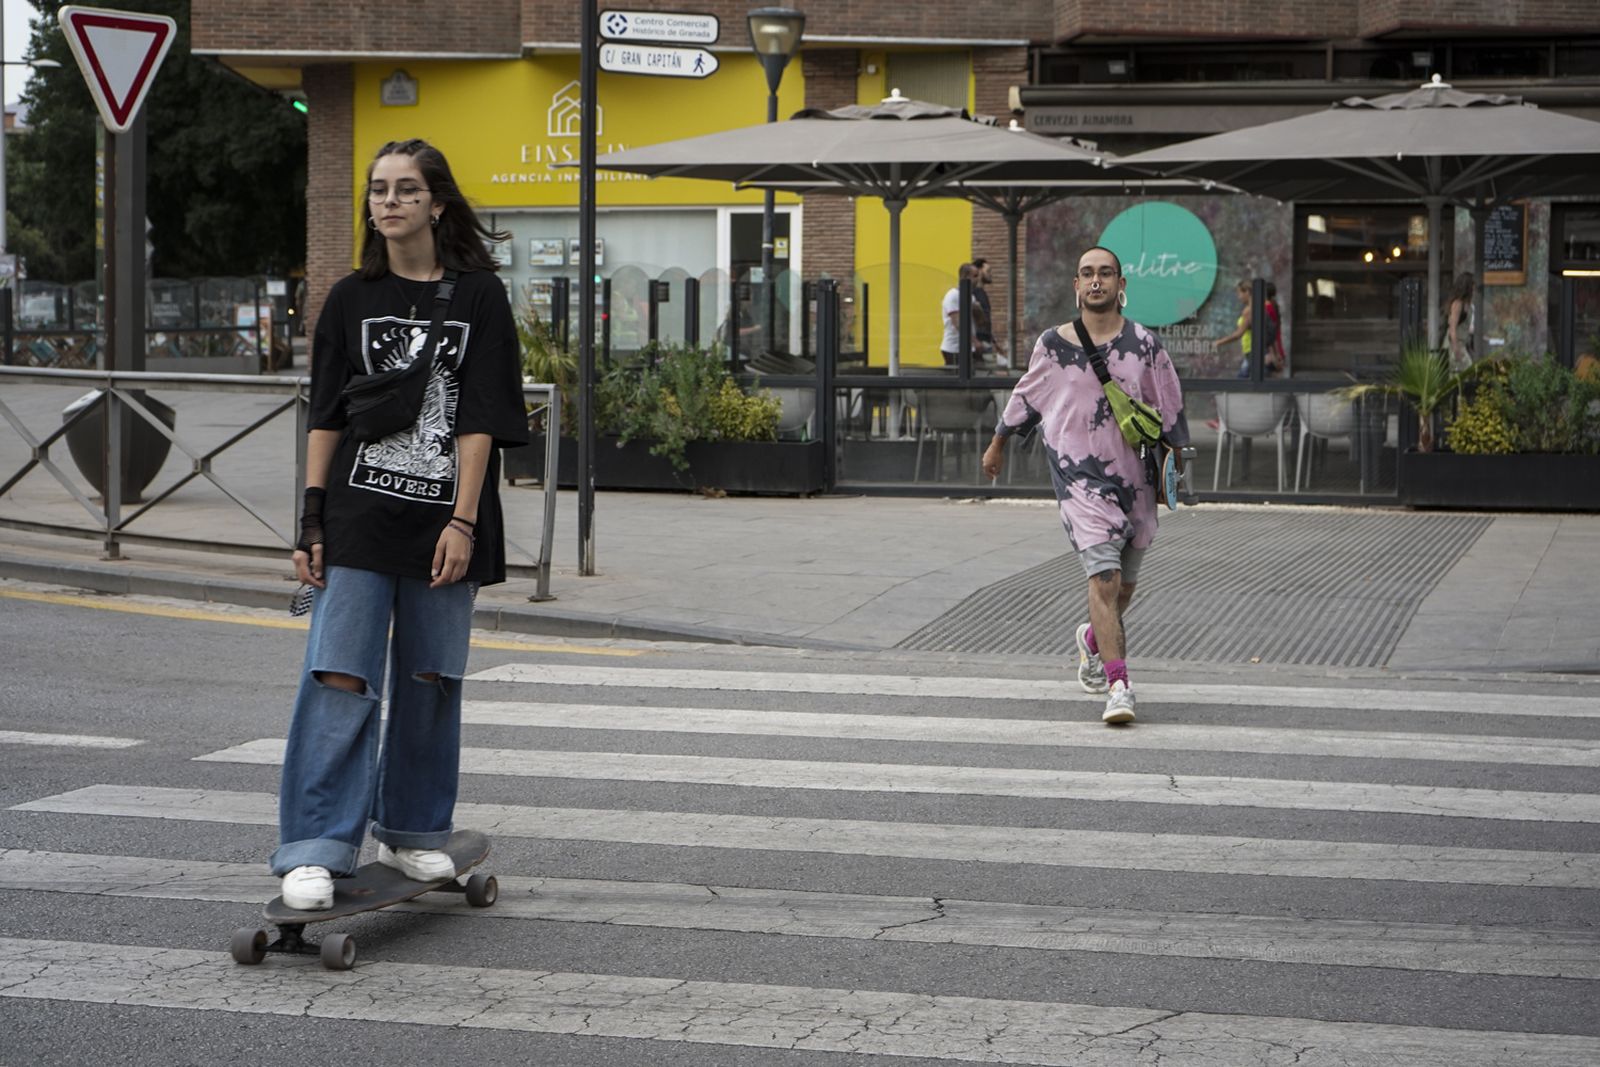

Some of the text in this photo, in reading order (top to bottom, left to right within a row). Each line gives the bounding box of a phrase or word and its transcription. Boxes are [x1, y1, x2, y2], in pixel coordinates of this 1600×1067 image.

[635, 16, 710, 28] Centro Comercial
[632, 26, 711, 38] Histórico de Granada
[605, 49, 682, 68] C/ GRAN CAPITÁN
[1082, 114, 1134, 126] ALHAMBRA
[491, 173, 551, 183] AGENCIA
[1121, 252, 1204, 277] alitre
[364, 469, 442, 498] LOVERS
